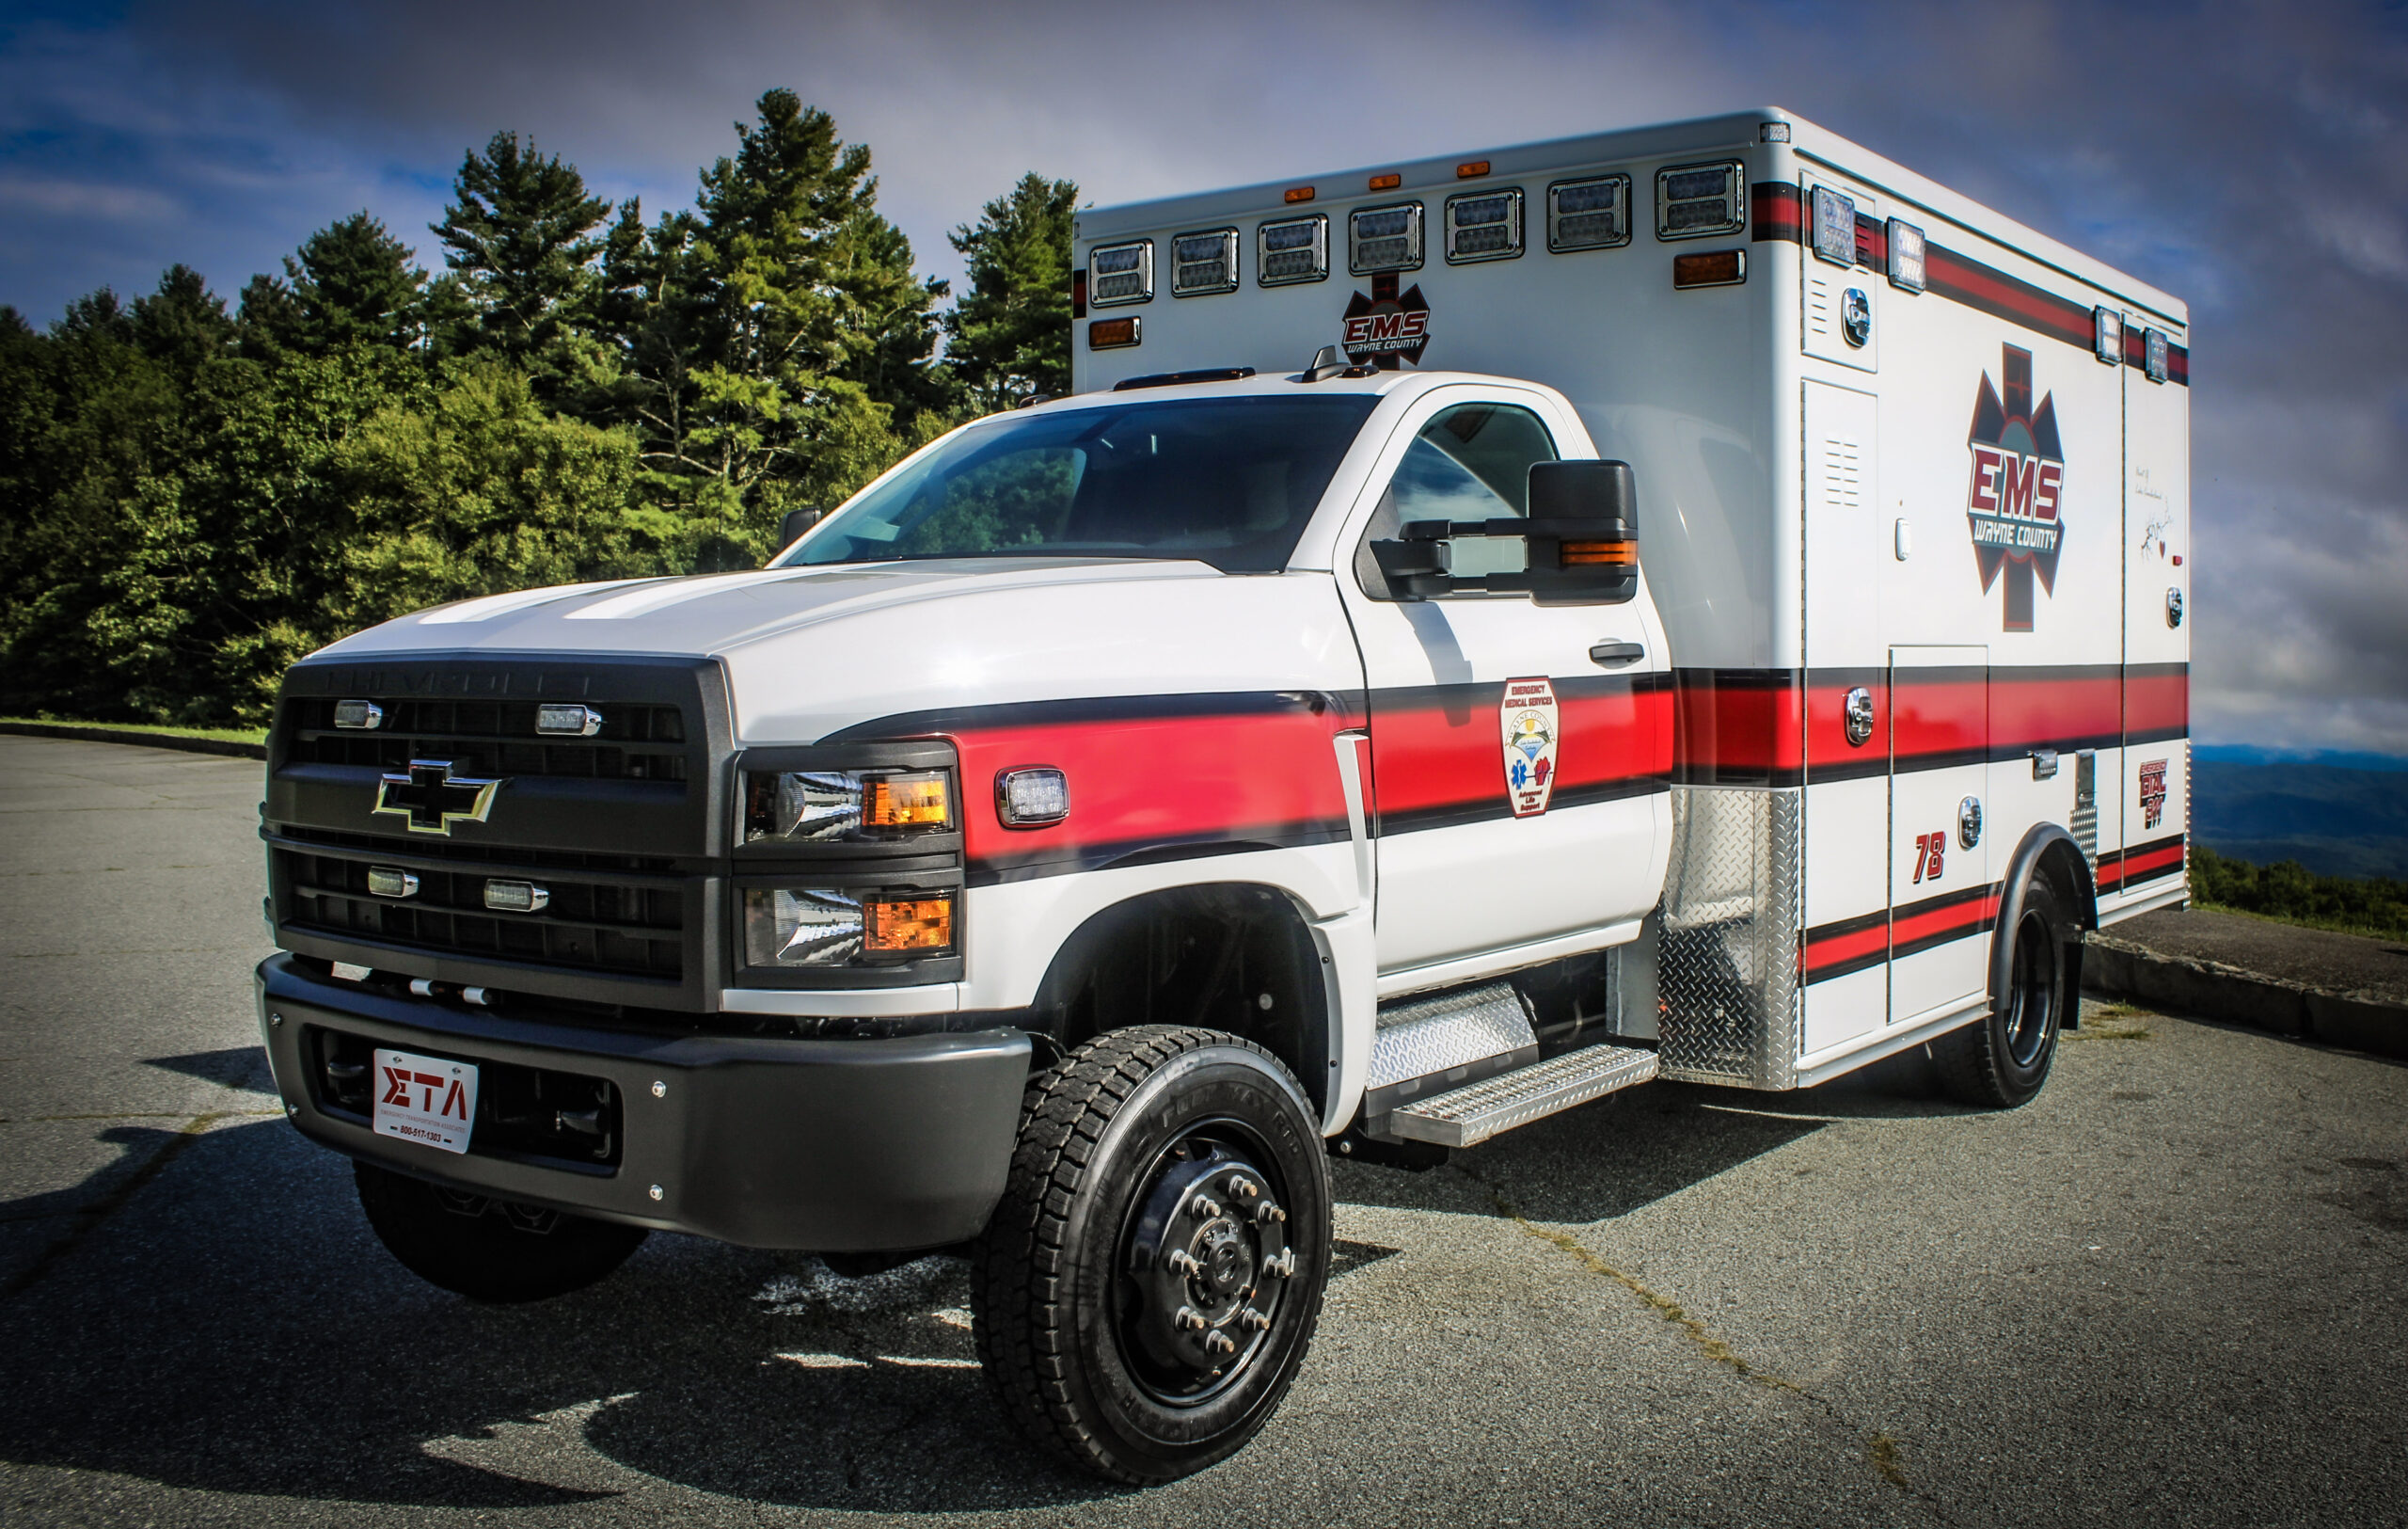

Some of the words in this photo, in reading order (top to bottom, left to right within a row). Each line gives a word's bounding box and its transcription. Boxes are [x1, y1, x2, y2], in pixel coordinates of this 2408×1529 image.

[1343, 310, 1429, 345] EMS
[1347, 341, 1382, 354] WAYNE
[1384, 337, 1423, 350] COUNTY
[1968, 442, 2064, 526] EMS
[1973, 518, 2016, 545] WAYNE
[2016, 525, 2058, 550] COUNTY
[1504, 697, 1528, 709] MEDICAL
[1529, 695, 1553, 708] SERVICES
[1511, 684, 1545, 696] EMERGENCY
[1525, 796, 1535, 804] Life
[2141, 772, 2167, 800] DIAL
[2145, 796, 2163, 829] 911
[1912, 831, 1946, 884] 78
[400, 1124, 441, 1142] 800-517-1303
